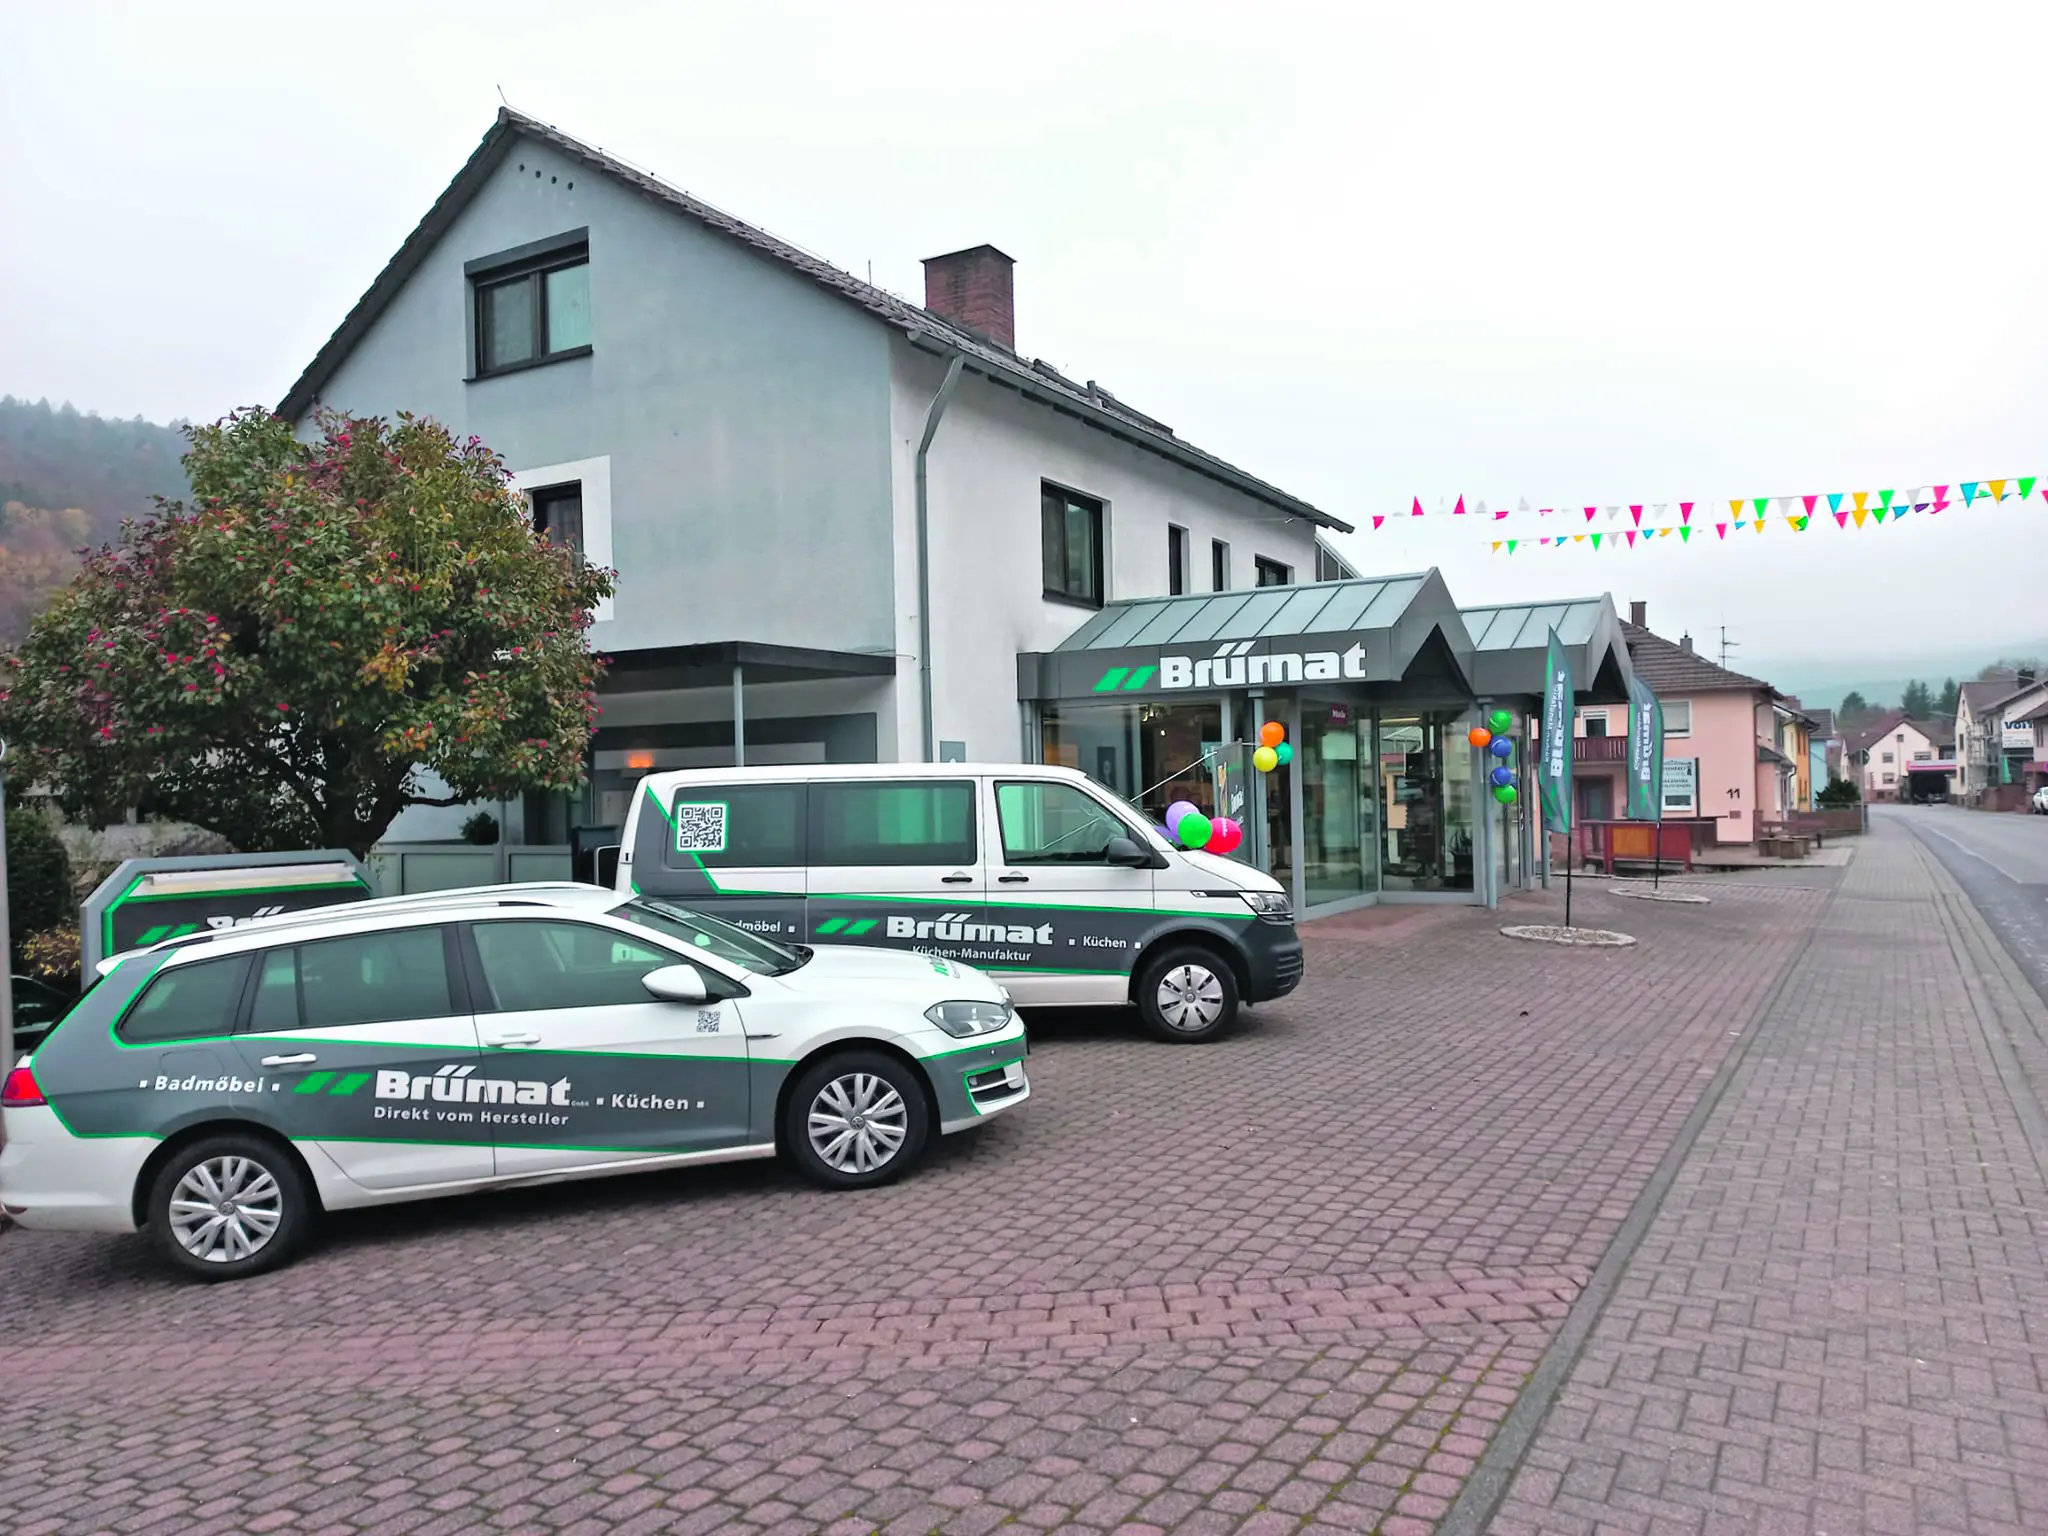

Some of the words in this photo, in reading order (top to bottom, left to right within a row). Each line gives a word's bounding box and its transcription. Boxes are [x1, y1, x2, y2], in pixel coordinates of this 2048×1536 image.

[1160, 640, 1366, 689] Brümat
[1726, 788, 1741, 799] 11
[886, 913, 1054, 945] Brümat
[1083, 936, 1127, 949] Küchen
[154, 1075, 264, 1093] Badmöbel
[375, 1064, 572, 1106] Brümat
[611, 1094, 689, 1110] Küchen
[374, 1106, 430, 1121] Direkt
[437, 1112, 473, 1122] vom
[480, 1112, 569, 1126] Hersteller
